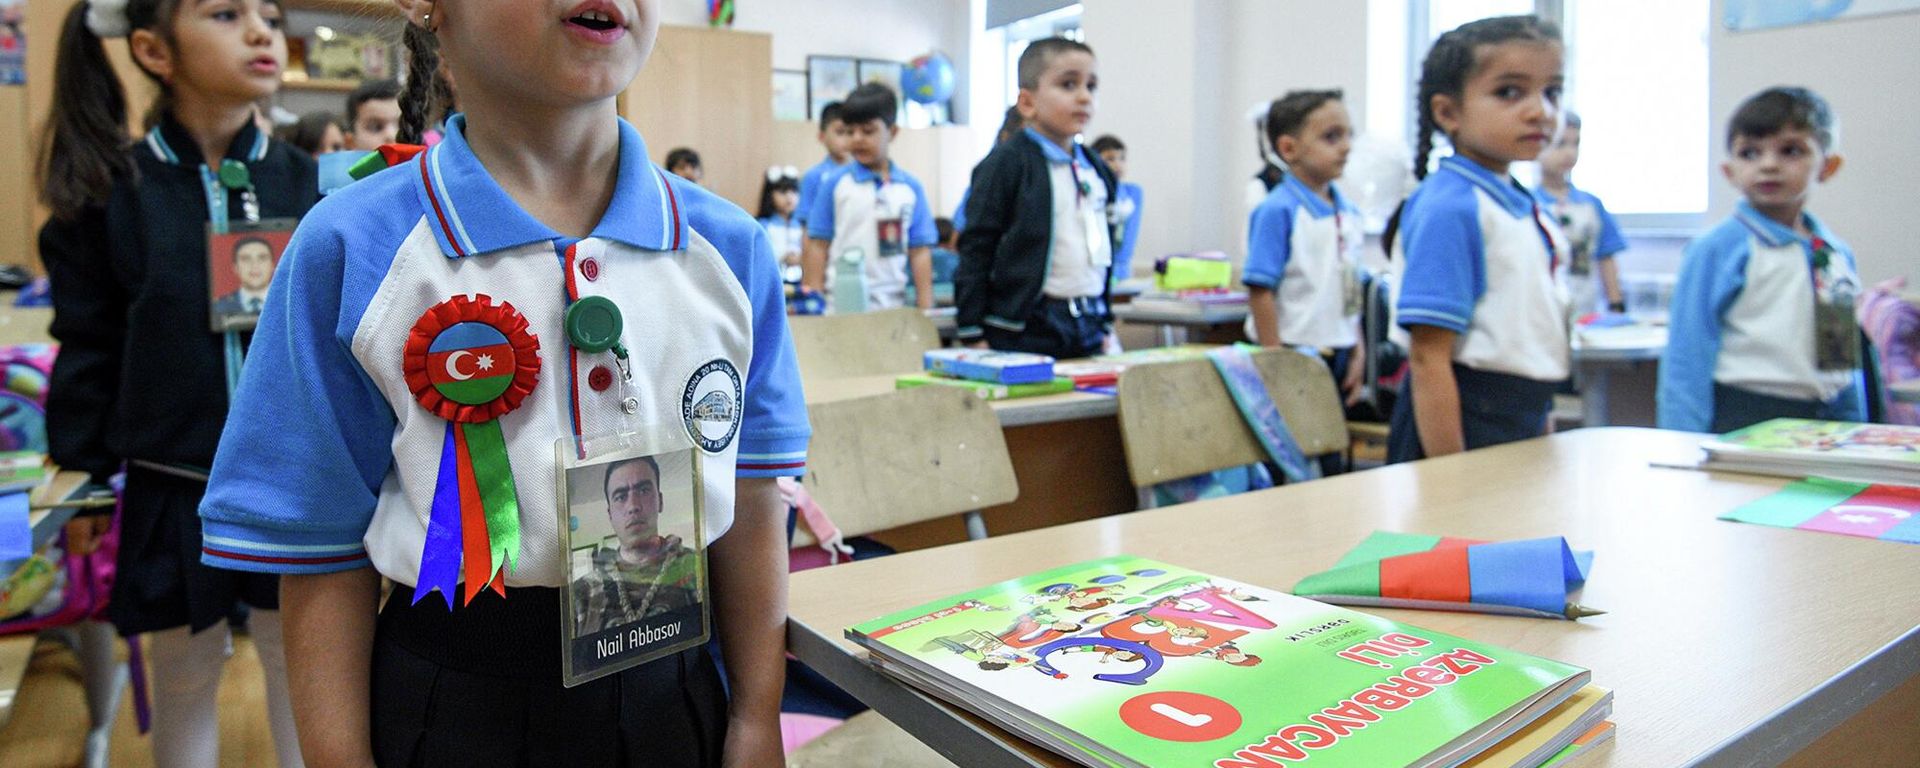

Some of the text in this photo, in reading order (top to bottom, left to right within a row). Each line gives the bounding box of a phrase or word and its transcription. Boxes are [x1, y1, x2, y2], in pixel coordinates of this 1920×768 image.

[597, 621, 681, 659] Nail Abbasov
[1337, 633, 1433, 668] DİLİ
[1150, 703, 1213, 727] 1
[1213, 648, 1497, 768] AZƏRBAYCAN
